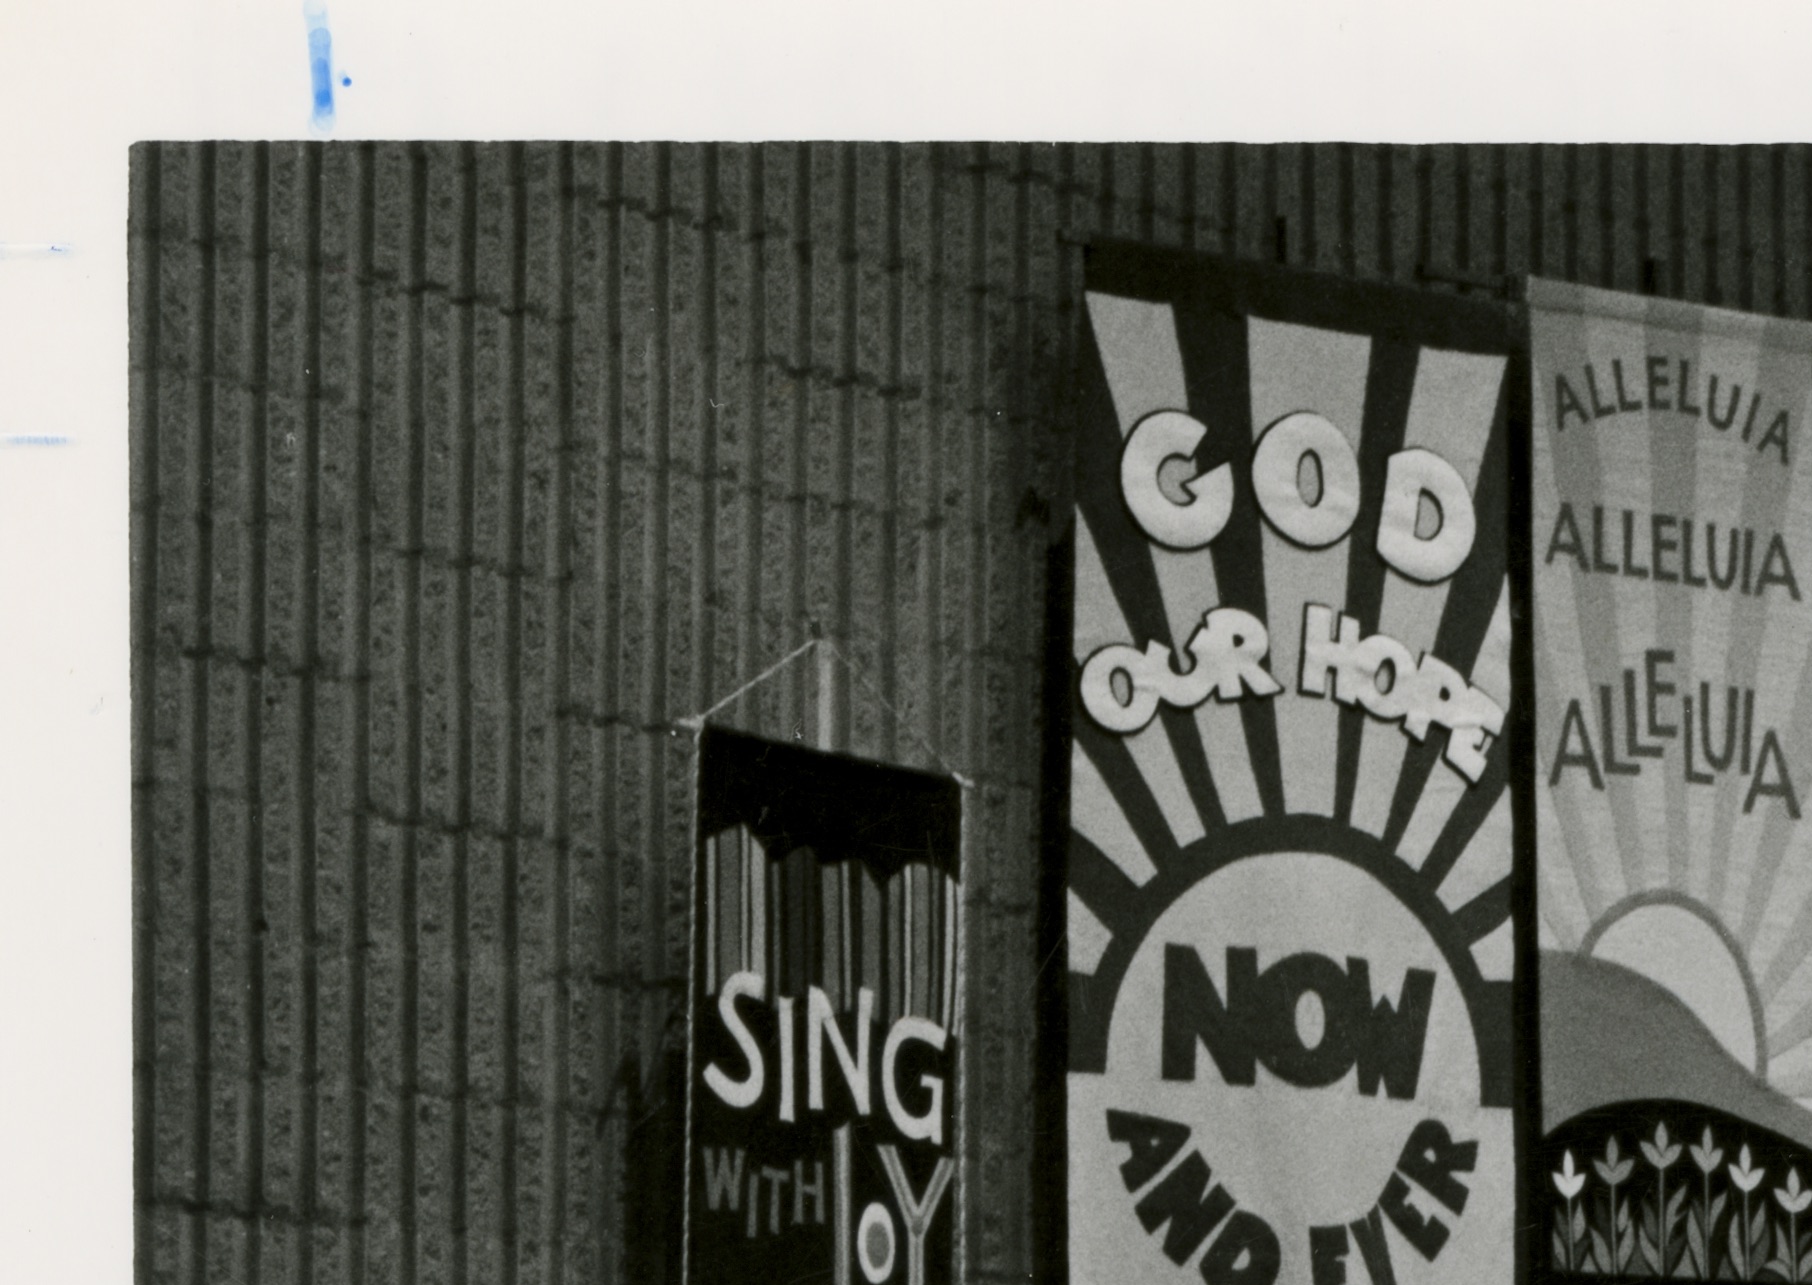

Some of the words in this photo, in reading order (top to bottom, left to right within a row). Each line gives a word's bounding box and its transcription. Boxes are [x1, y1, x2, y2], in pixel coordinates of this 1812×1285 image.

[1555, 354, 1791, 466] ALLELUIA
[1120, 408, 1477, 586] GOD
[1544, 501, 1804, 602] ALLELUIA
[1080, 606, 1285, 734] OUR
[1298, 601, 1509, 786] HOPE
[1547, 648, 1803, 820] ALLELUIA
[702, 970, 948, 1146] SING
[1160, 941, 1438, 1101] NOW
[701, 1146, 825, 1239] WITH
